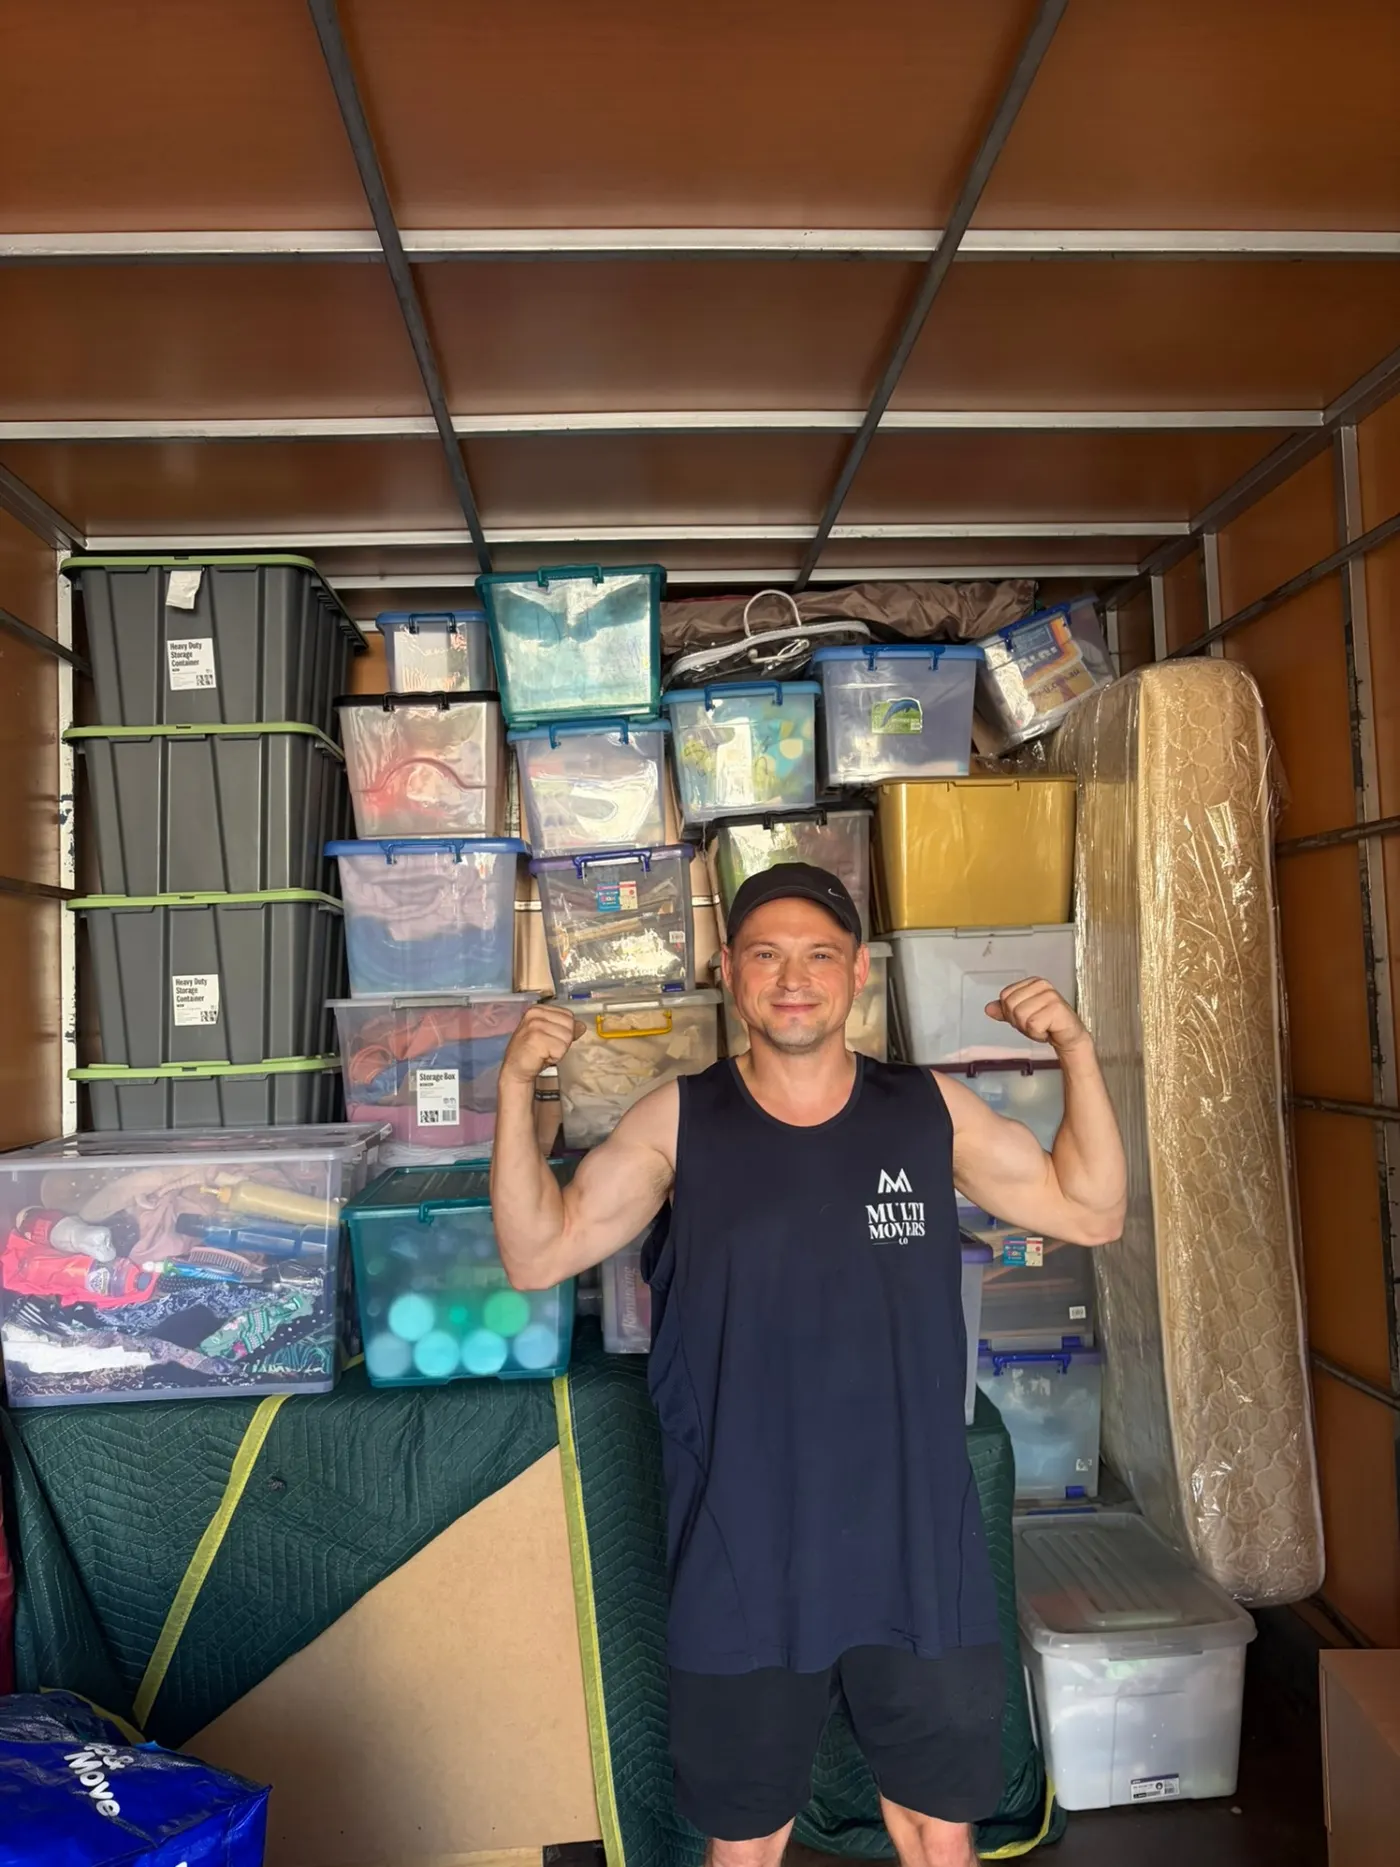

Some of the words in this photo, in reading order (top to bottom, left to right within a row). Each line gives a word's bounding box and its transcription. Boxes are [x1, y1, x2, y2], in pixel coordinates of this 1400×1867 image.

[170, 642, 188, 651] Heavy
[188, 641, 203, 651] Duty
[170, 651, 193, 660] Storage
[171, 659, 200, 667] Container
[175, 978, 193, 987] Heavy
[194, 977, 208, 987] Duty
[175, 986, 199, 996] Storage
[176, 995, 205, 1003] Container
[419, 1072, 443, 1082] Storage
[443, 1071, 456, 1081] Box
[865, 1202, 926, 1224] MULTI
[868, 1221, 926, 1240] MOVERS
[63, 1751, 121, 1817] Move
